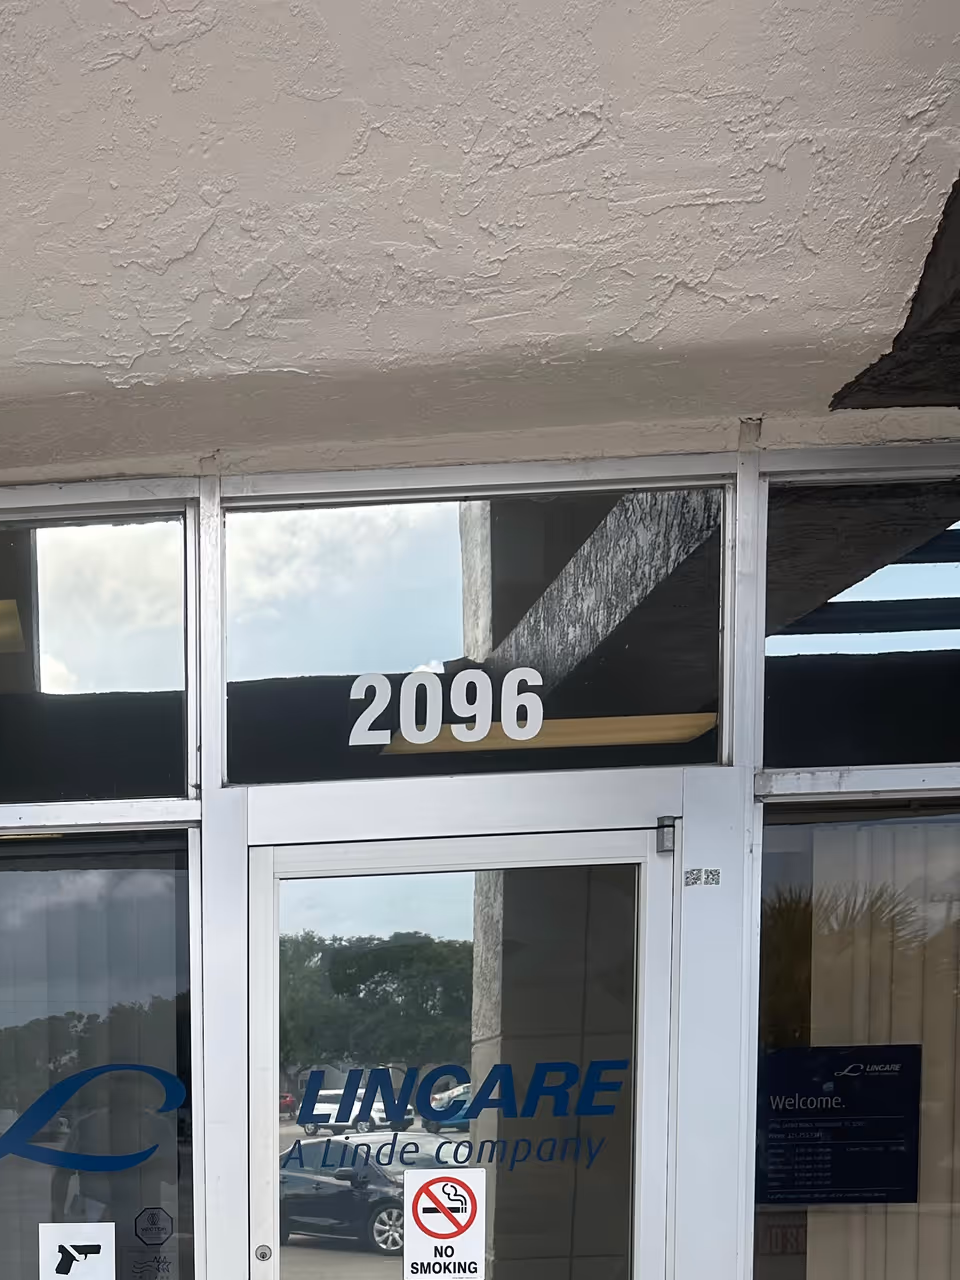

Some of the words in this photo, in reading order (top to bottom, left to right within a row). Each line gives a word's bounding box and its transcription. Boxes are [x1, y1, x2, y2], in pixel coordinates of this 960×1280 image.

[348, 667, 544, 746] 2096
[865, 1063, 903, 1072] LINCARE
[296, 1058, 630, 1125] LINCARE
[769, 1093, 846, 1109] Welcome.
[282, 1139, 305, 1169] A
[320, 1132, 420, 1168] Linde
[435, 1136, 606, 1172] company
[433, 1245, 455, 1258] NO
[410, 1261, 478, 1275] SMOKING
